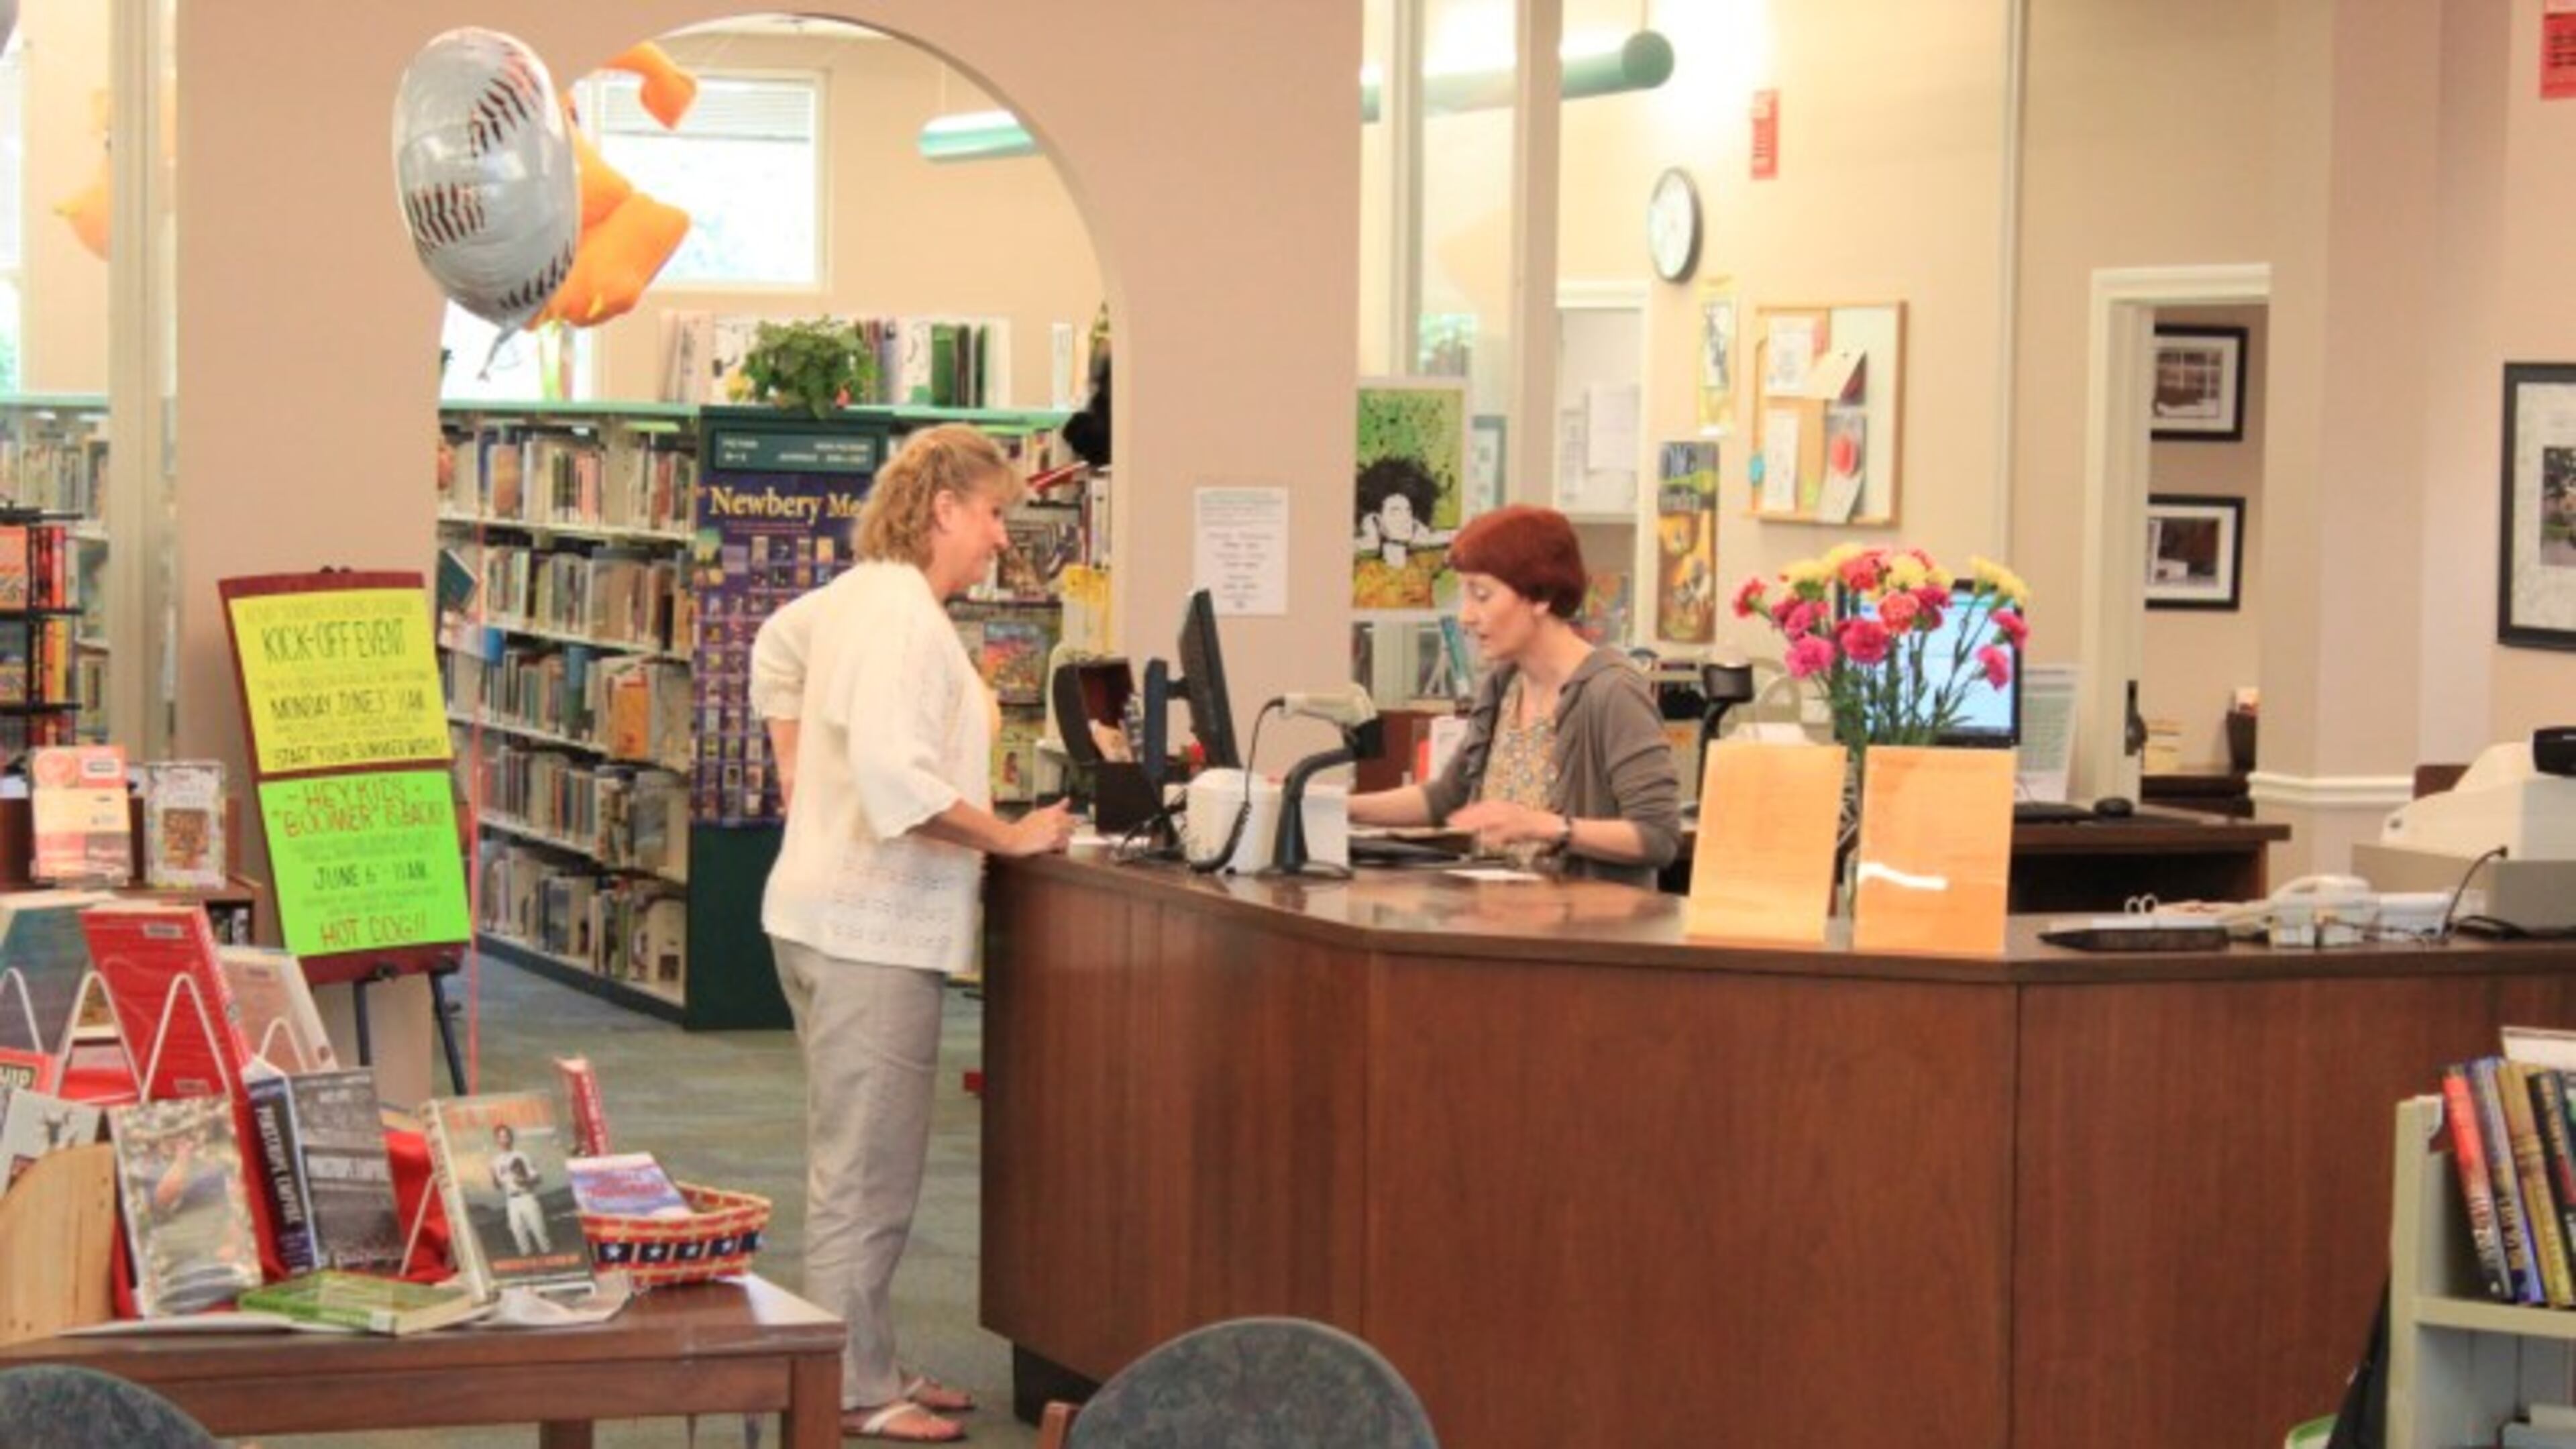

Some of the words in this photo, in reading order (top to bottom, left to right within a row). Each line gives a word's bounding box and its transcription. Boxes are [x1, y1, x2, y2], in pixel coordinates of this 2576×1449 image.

[708, 486, 824, 526] Newbery
[826, 492, 862, 517] Me
[260, 621, 350, 663] KICK-OFF
[354, 617, 405, 658] EVENT
[270, 694, 331, 720] MONDAY
[337, 690, 376, 716] JUNE
[304, 781, 350, 810] HEY
[314, 863, 358, 890] JUNE
[319, 918, 360, 947] HOT
